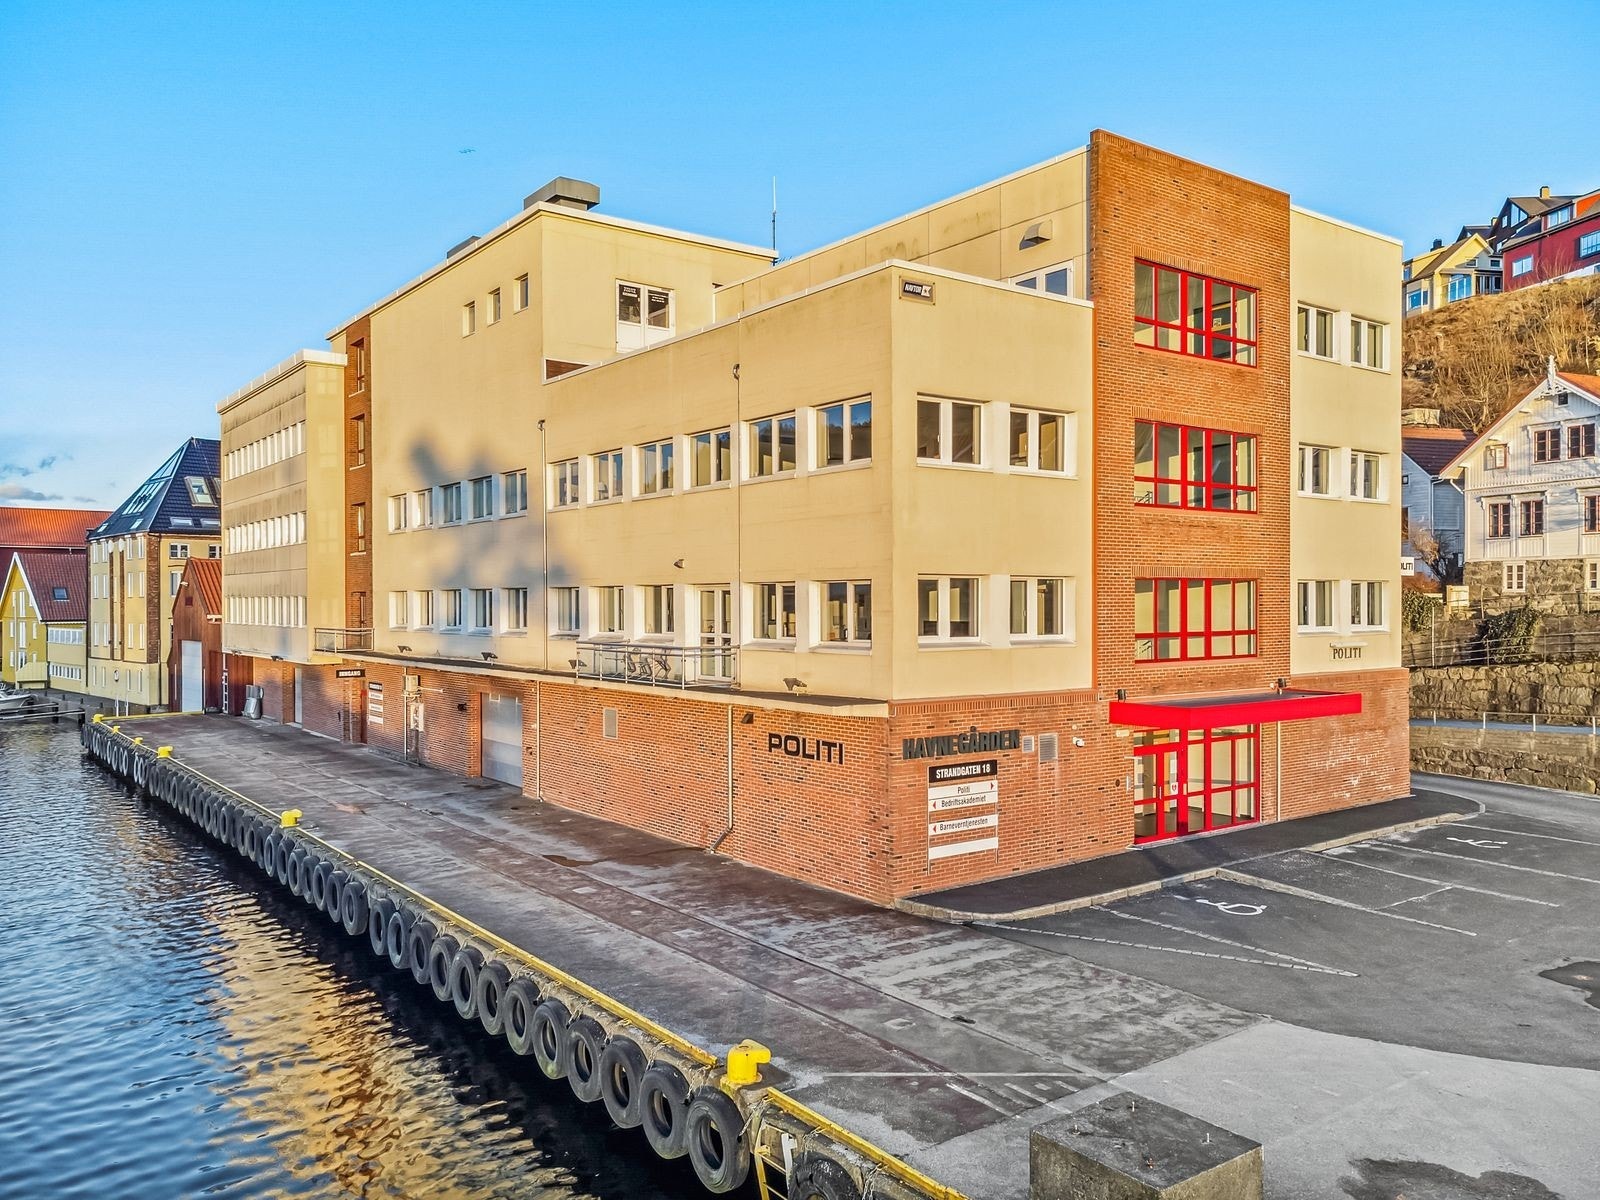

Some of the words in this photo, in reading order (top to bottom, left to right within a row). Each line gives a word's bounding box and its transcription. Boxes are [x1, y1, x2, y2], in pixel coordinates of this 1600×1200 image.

[1332, 647, 1361, 659] POLITI
[768, 733, 843, 765] POLITI
[902, 726, 1020, 760] HAVNEGÅRDEN
[936, 764, 981, 779] STRANDGATEN
[981, 763, 991, 773] 18
[957, 786, 971, 794] Politi
[941, 795, 986, 807] Bedriftsakademiet
[939, 818, 988, 831] Barneverntjenesten
